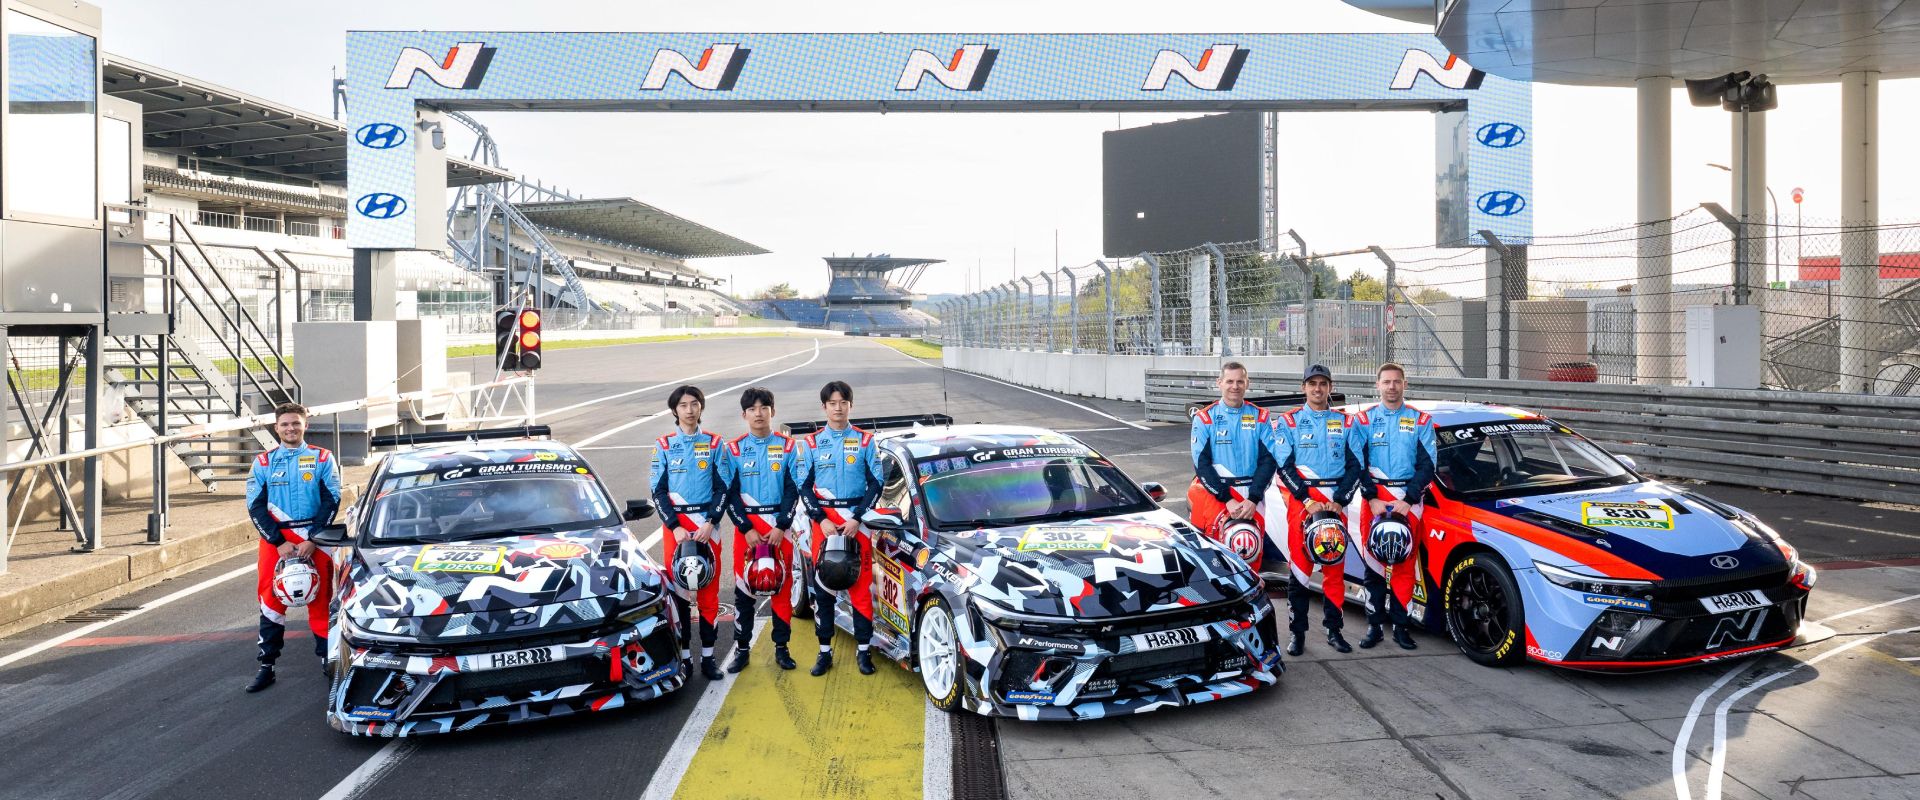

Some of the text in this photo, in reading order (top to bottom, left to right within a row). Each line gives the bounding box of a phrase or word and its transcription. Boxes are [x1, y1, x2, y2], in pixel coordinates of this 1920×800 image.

[1480, 423, 1552, 434] GRAN TURISMO
[1003, 446, 1083, 457] GRAN TURISMO
[479, 463, 573, 473] GRAN TURISMO
[1602, 507, 1652, 519] 830
[1613, 520, 1664, 529] DEKRA
[1043, 532, 1088, 541] 302
[437, 552, 484, 562] 303
[445, 563, 494, 571] DEKRA
[883, 575, 899, 608] 302
[1586, 596, 1647, 609] GOODYEAR
[1496, 629, 1516, 660] EAGLE
[1527, 645, 1563, 658] sparco
[1009, 693, 1053, 701] GOODYEAR
[352, 708, 392, 718] GOODYEAR
